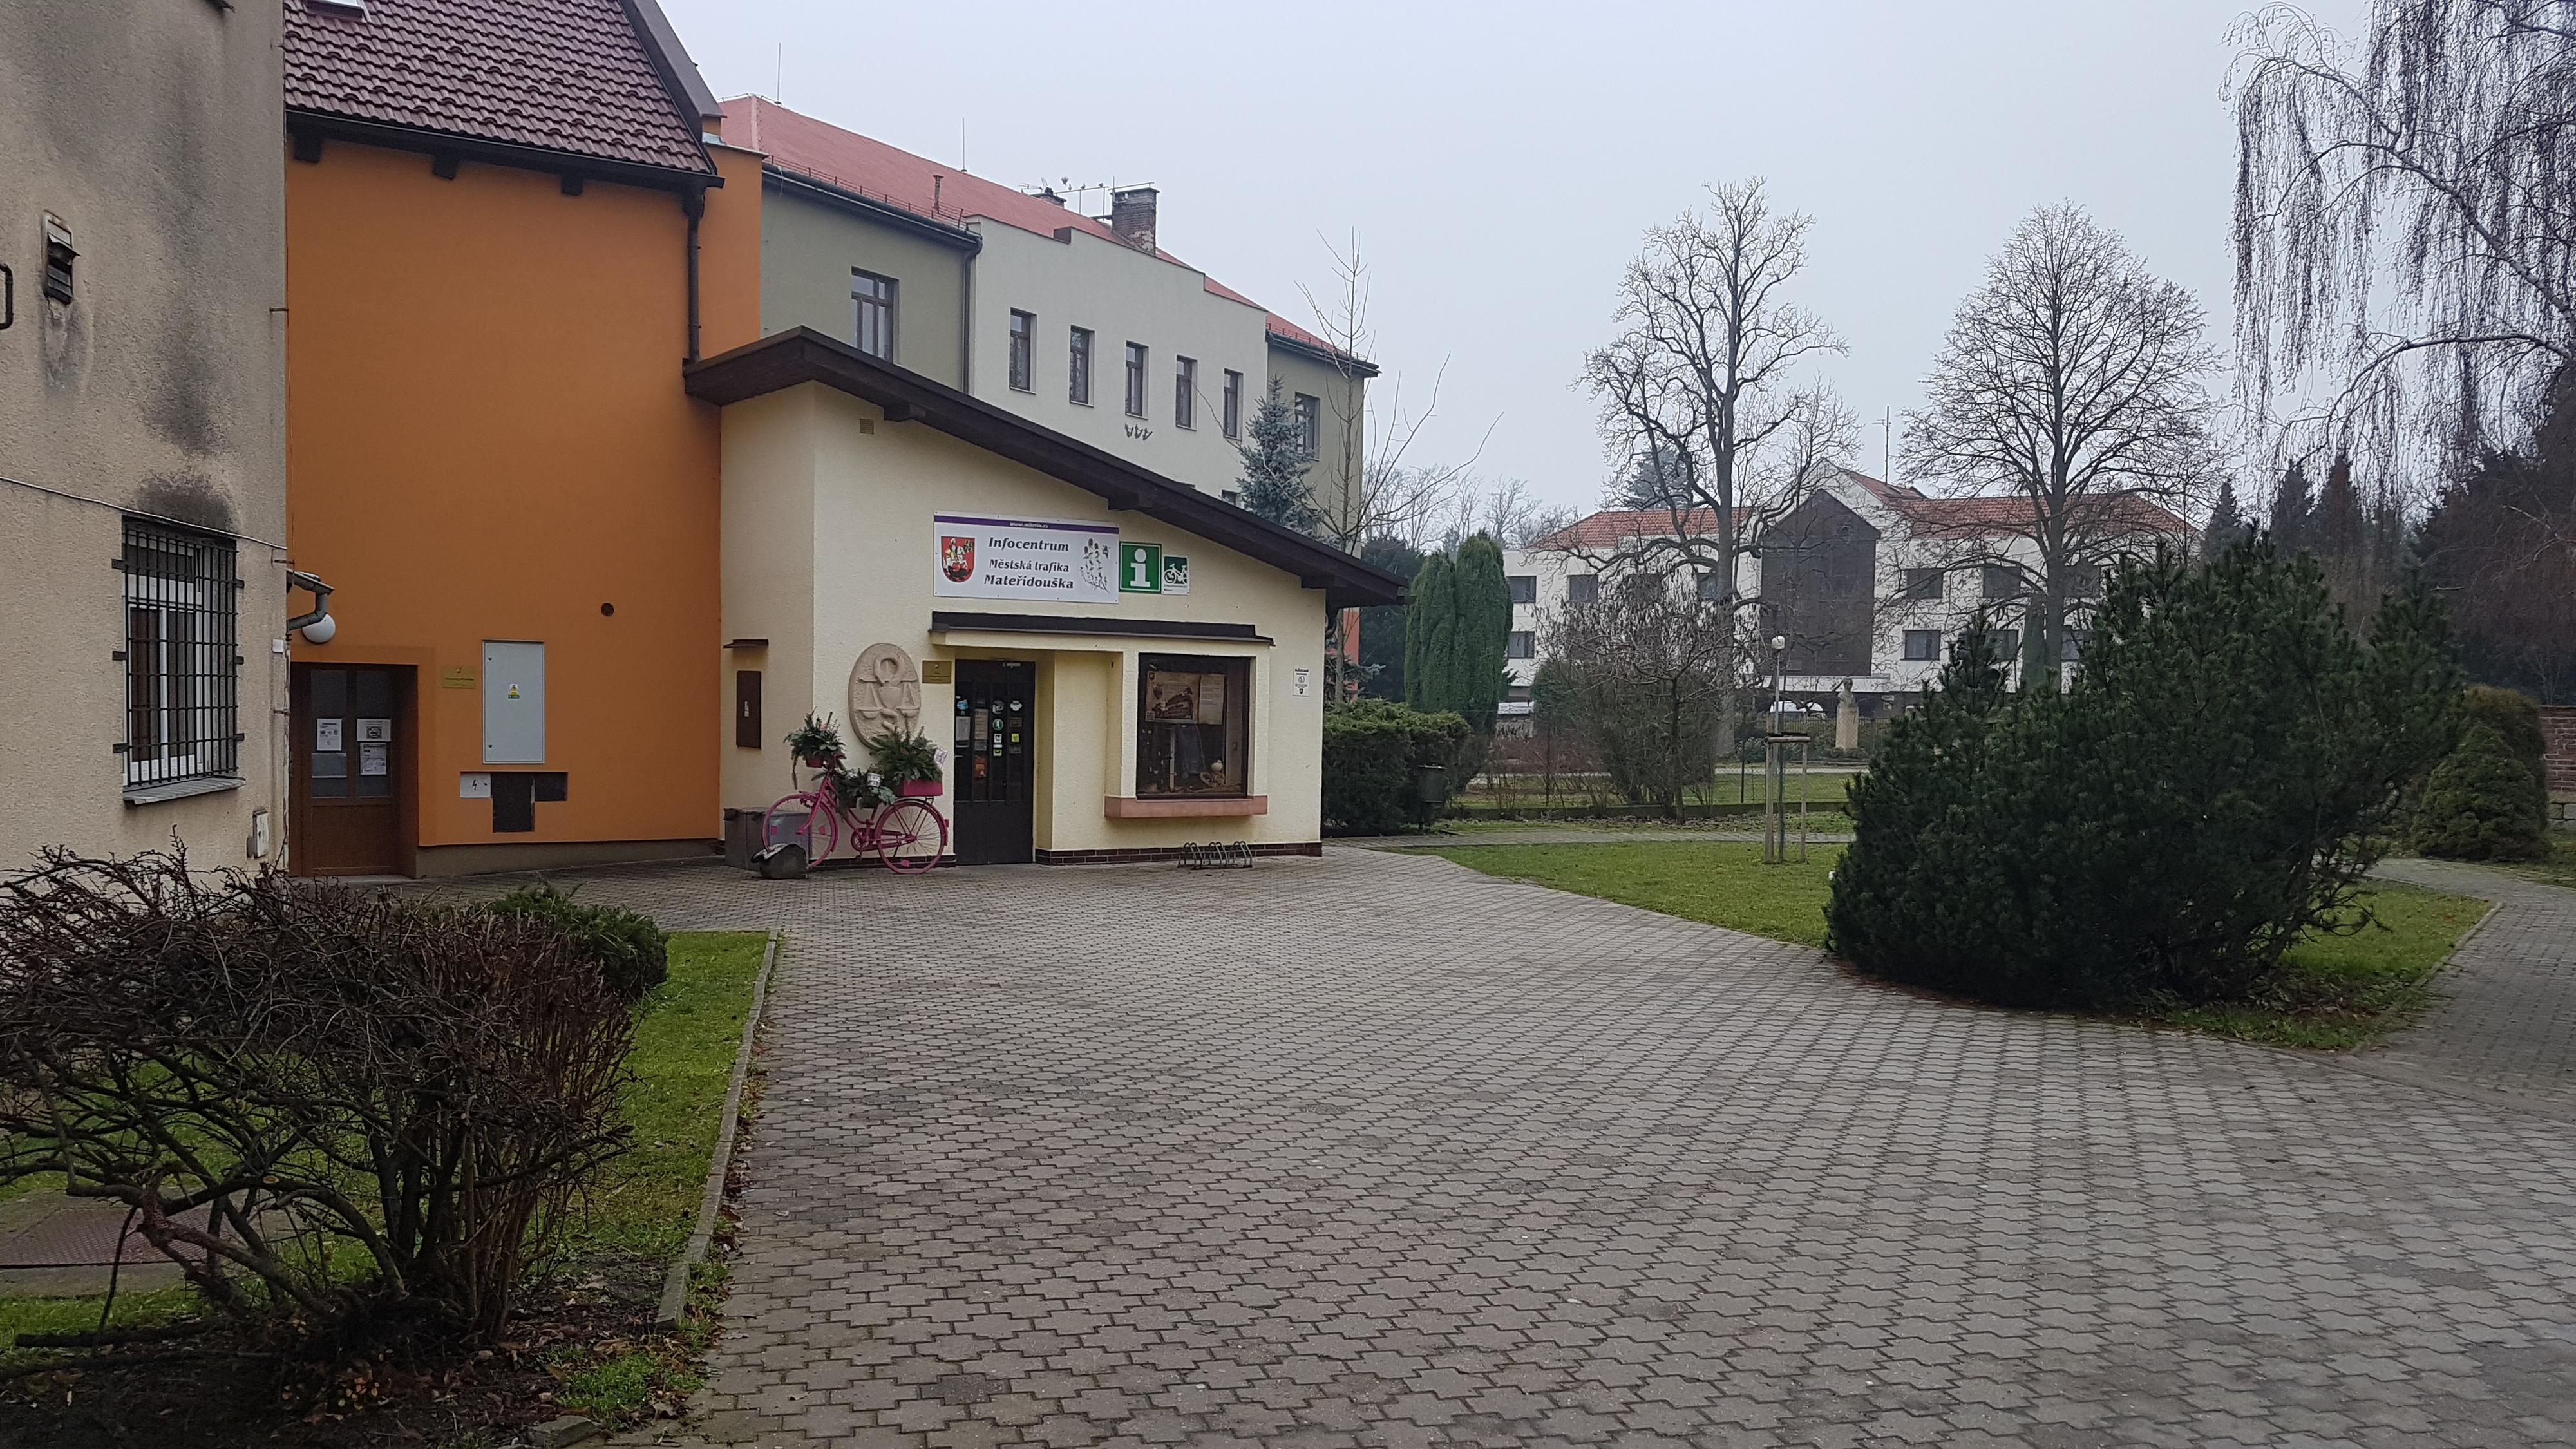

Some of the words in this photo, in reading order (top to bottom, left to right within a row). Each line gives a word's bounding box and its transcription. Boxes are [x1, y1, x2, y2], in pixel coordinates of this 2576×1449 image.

[989, 537, 1069, 551] Infocentrum
[989, 558, 1032, 570] Městská
[1034, 562, 1069, 573] trafika
[984, 574, 1074, 589] Mateřídouška
